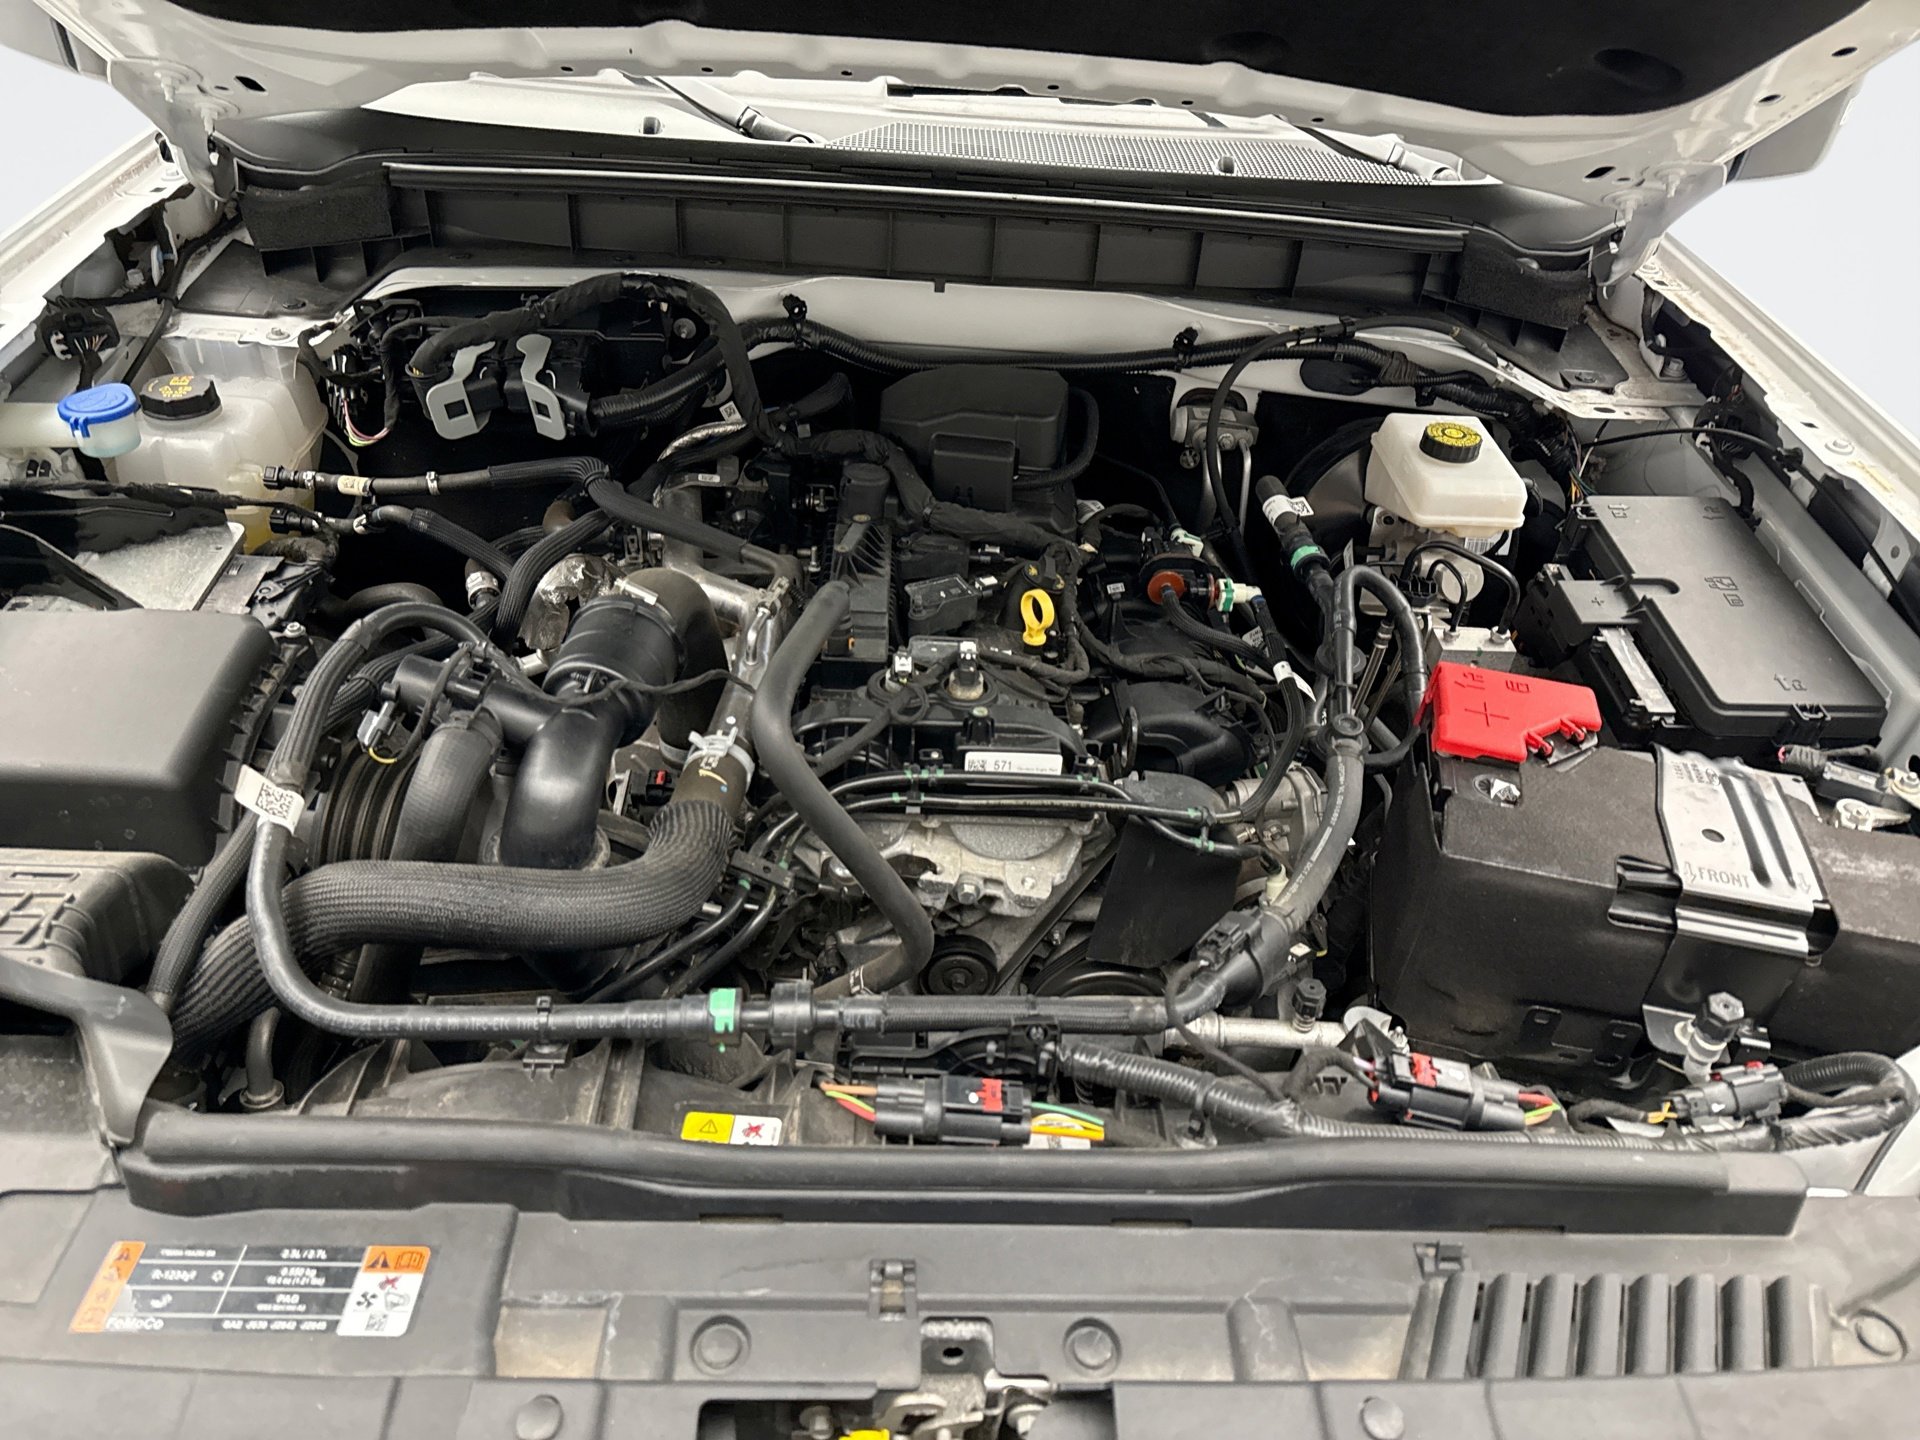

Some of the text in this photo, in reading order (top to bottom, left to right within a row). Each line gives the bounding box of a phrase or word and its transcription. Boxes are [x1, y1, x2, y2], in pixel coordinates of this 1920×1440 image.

[993, 760, 1012, 771] 571
[1698, 866, 1750, 888] FRONT
[151, 1269, 197, 1282] R-1234yf
[105, 1317, 164, 1330] FoMoCo
